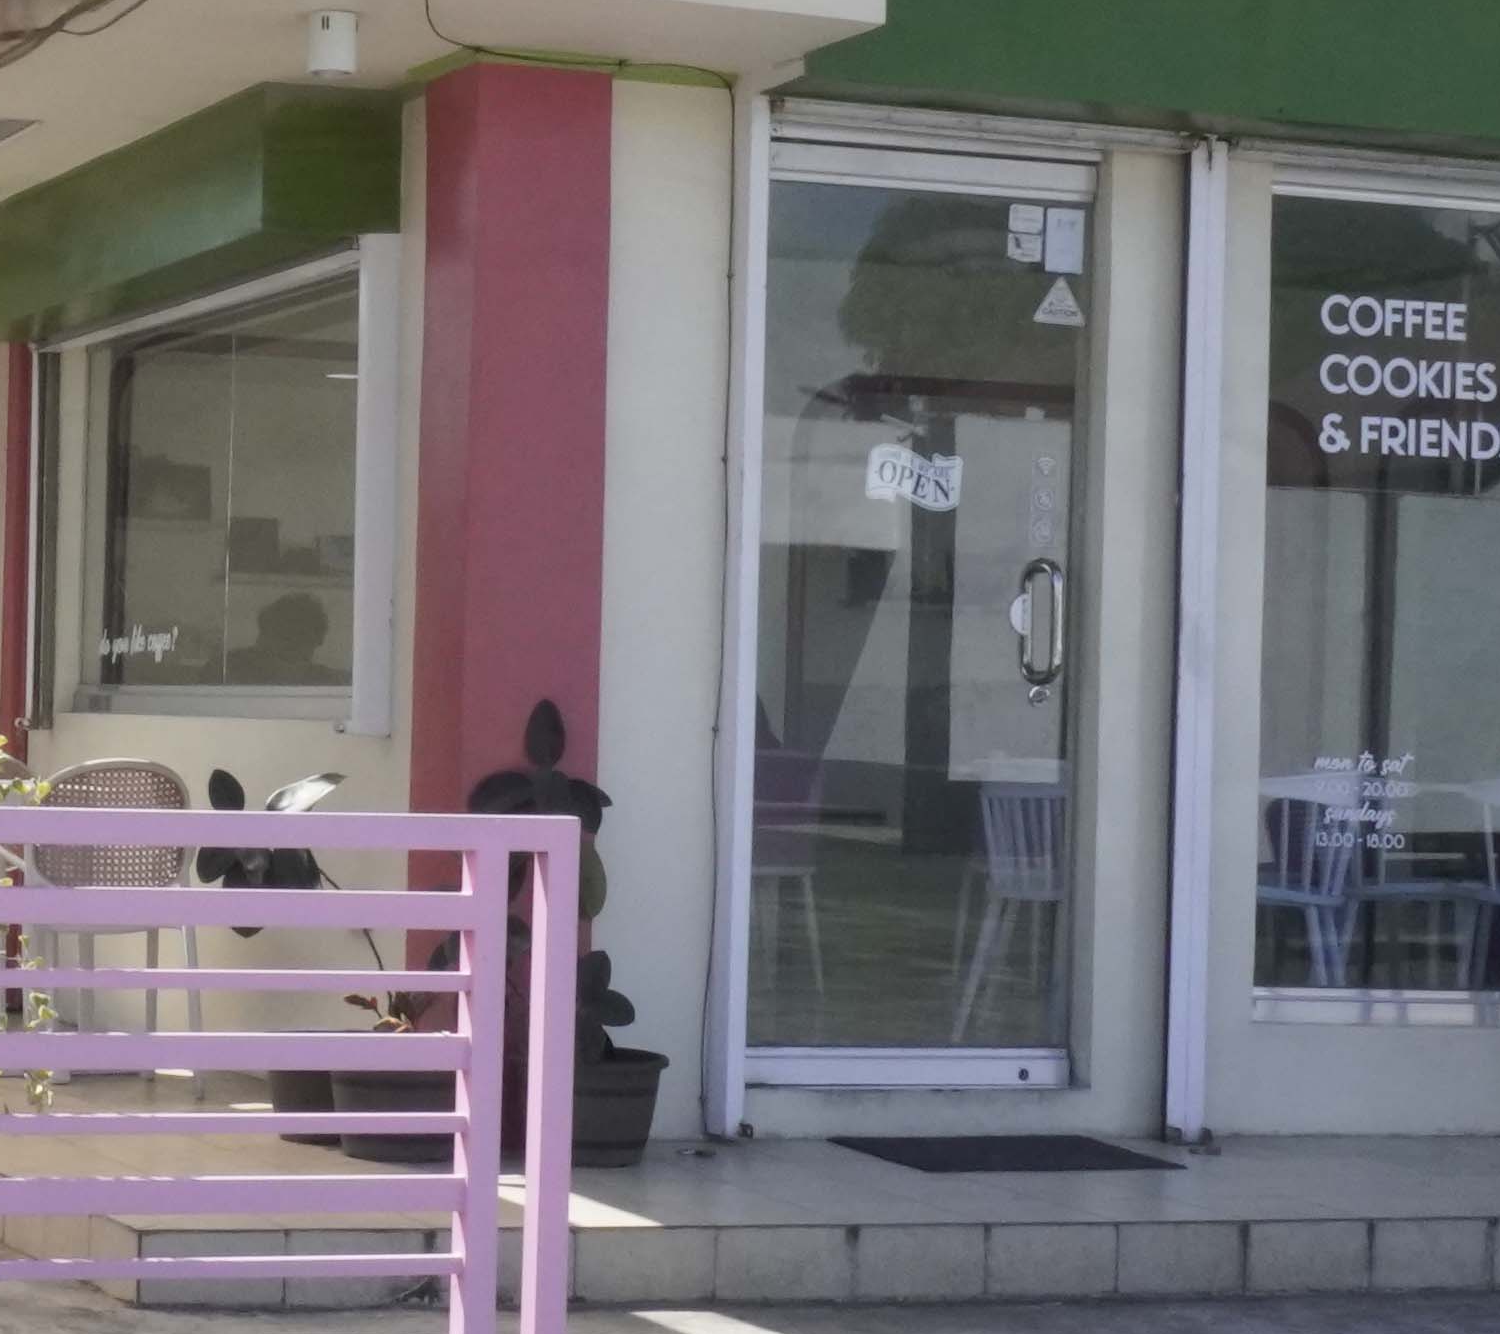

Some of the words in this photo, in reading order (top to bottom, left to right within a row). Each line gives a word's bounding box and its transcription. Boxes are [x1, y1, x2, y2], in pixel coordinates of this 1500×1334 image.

[1320, 293, 1468, 342] COFFEE
[1319, 353, 1498, 403] COOKIES
[1318, 412, 1351, 454] &
[879, 459, 951, 503] OPEN
